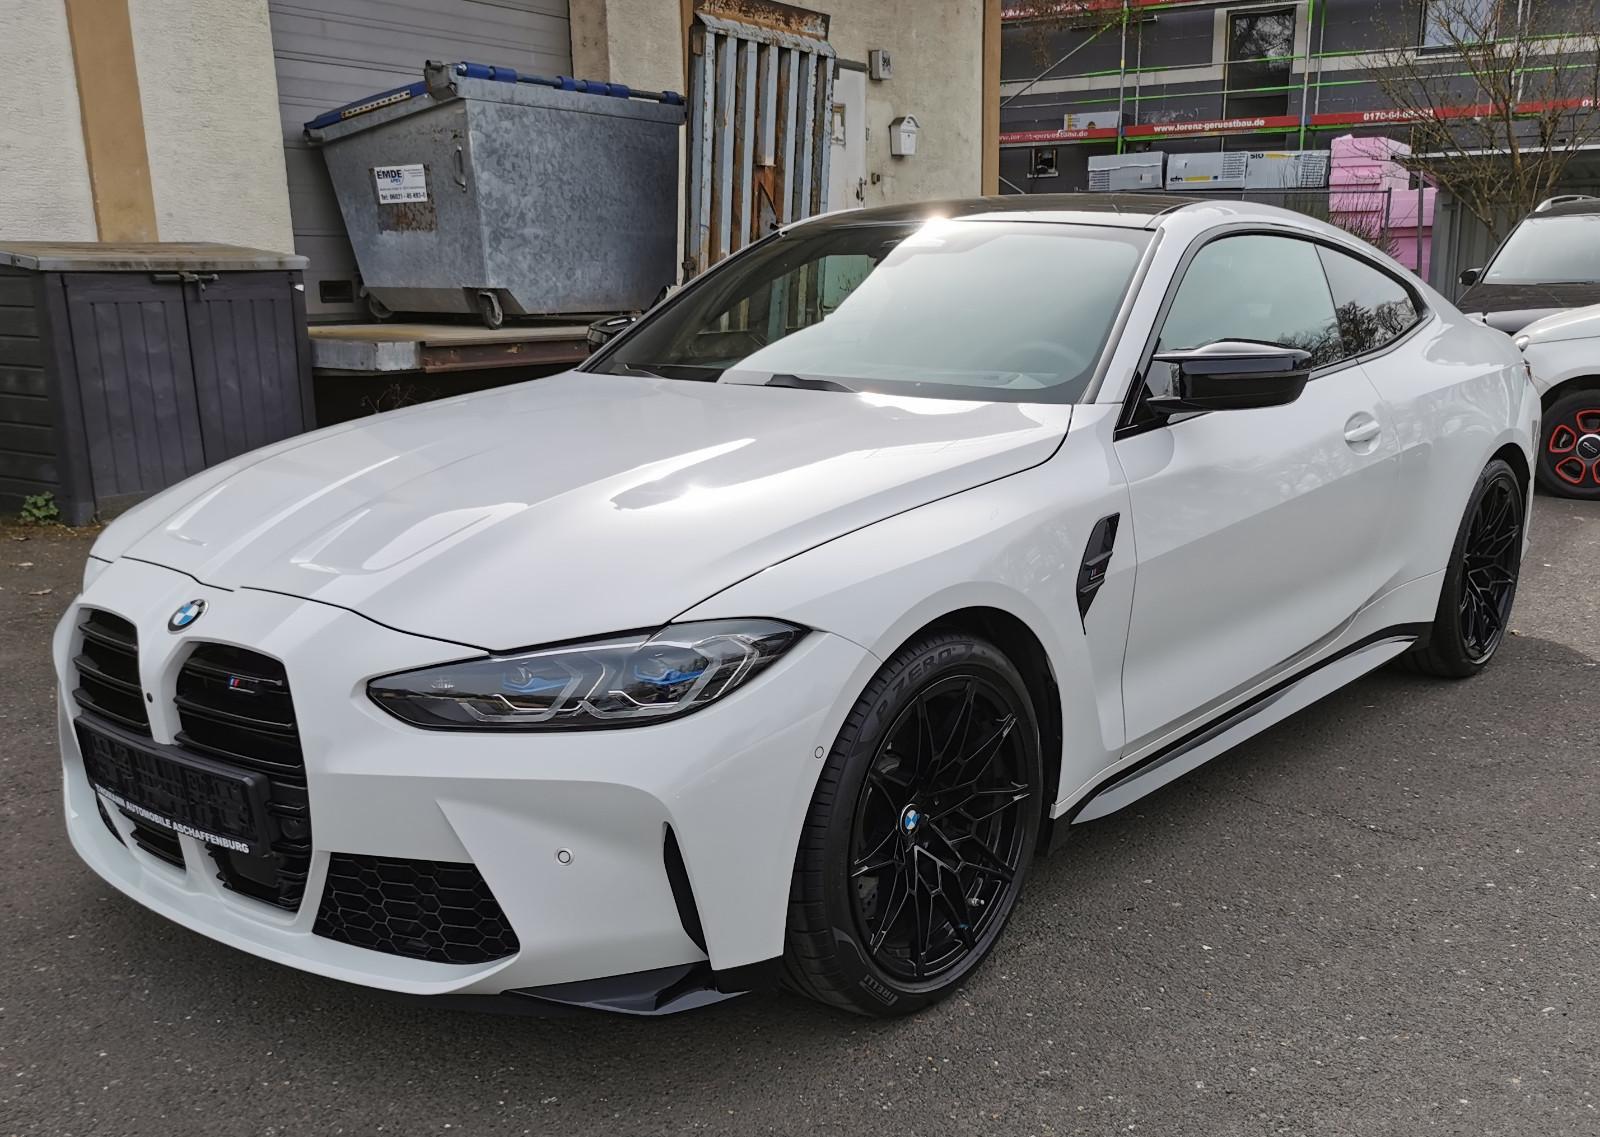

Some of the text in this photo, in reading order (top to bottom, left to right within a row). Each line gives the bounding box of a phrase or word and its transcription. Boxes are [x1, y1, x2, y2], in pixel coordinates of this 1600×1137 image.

[1154, 118, 1265, 133] www.lorenz-geruestbau.de
[376, 169, 402, 180] EMDE
[126, 801, 172, 829] AUTOMOBILE
[172, 822, 249, 854] ASCHAFFENBURG
